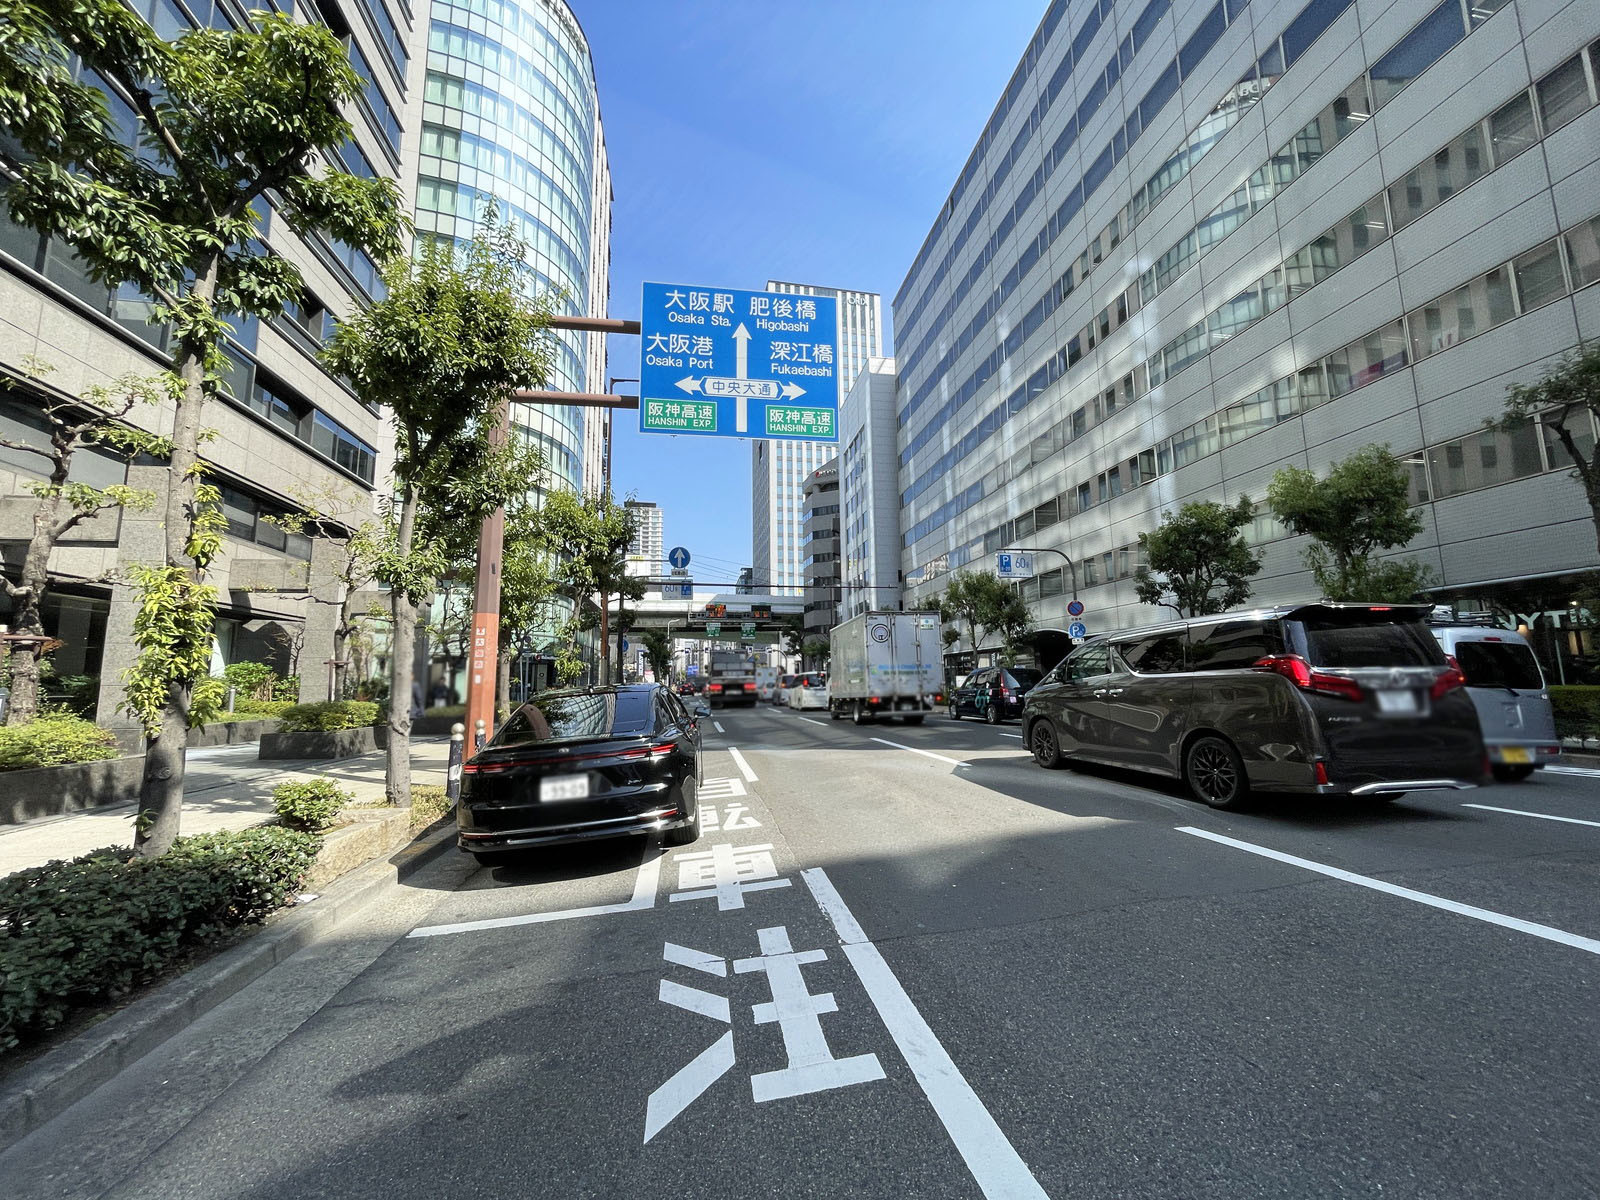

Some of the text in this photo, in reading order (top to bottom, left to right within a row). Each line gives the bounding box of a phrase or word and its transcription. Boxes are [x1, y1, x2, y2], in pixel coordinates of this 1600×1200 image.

[664, 289, 735, 314] 大阪駅
[749, 296, 817, 320] 肥後橋
[668, 311, 732, 327] Osaka Sta.
[756, 318, 809, 333] Higobashi
[646, 332, 713, 356] 大阪港
[769, 341, 833, 364] 深江橋
[646, 354, 714, 369] Osaka Port
[771, 363, 833, 377] Fukaebashi
[712, 380, 771, 396] 中央大通
[648, 402, 713, 419] 阪神高速
[769, 409, 832, 426] 阪神高速
[648, 417, 714, 428] HANSHIN EXP.
[769, 424, 832, 434] HANSHIN EXP.
